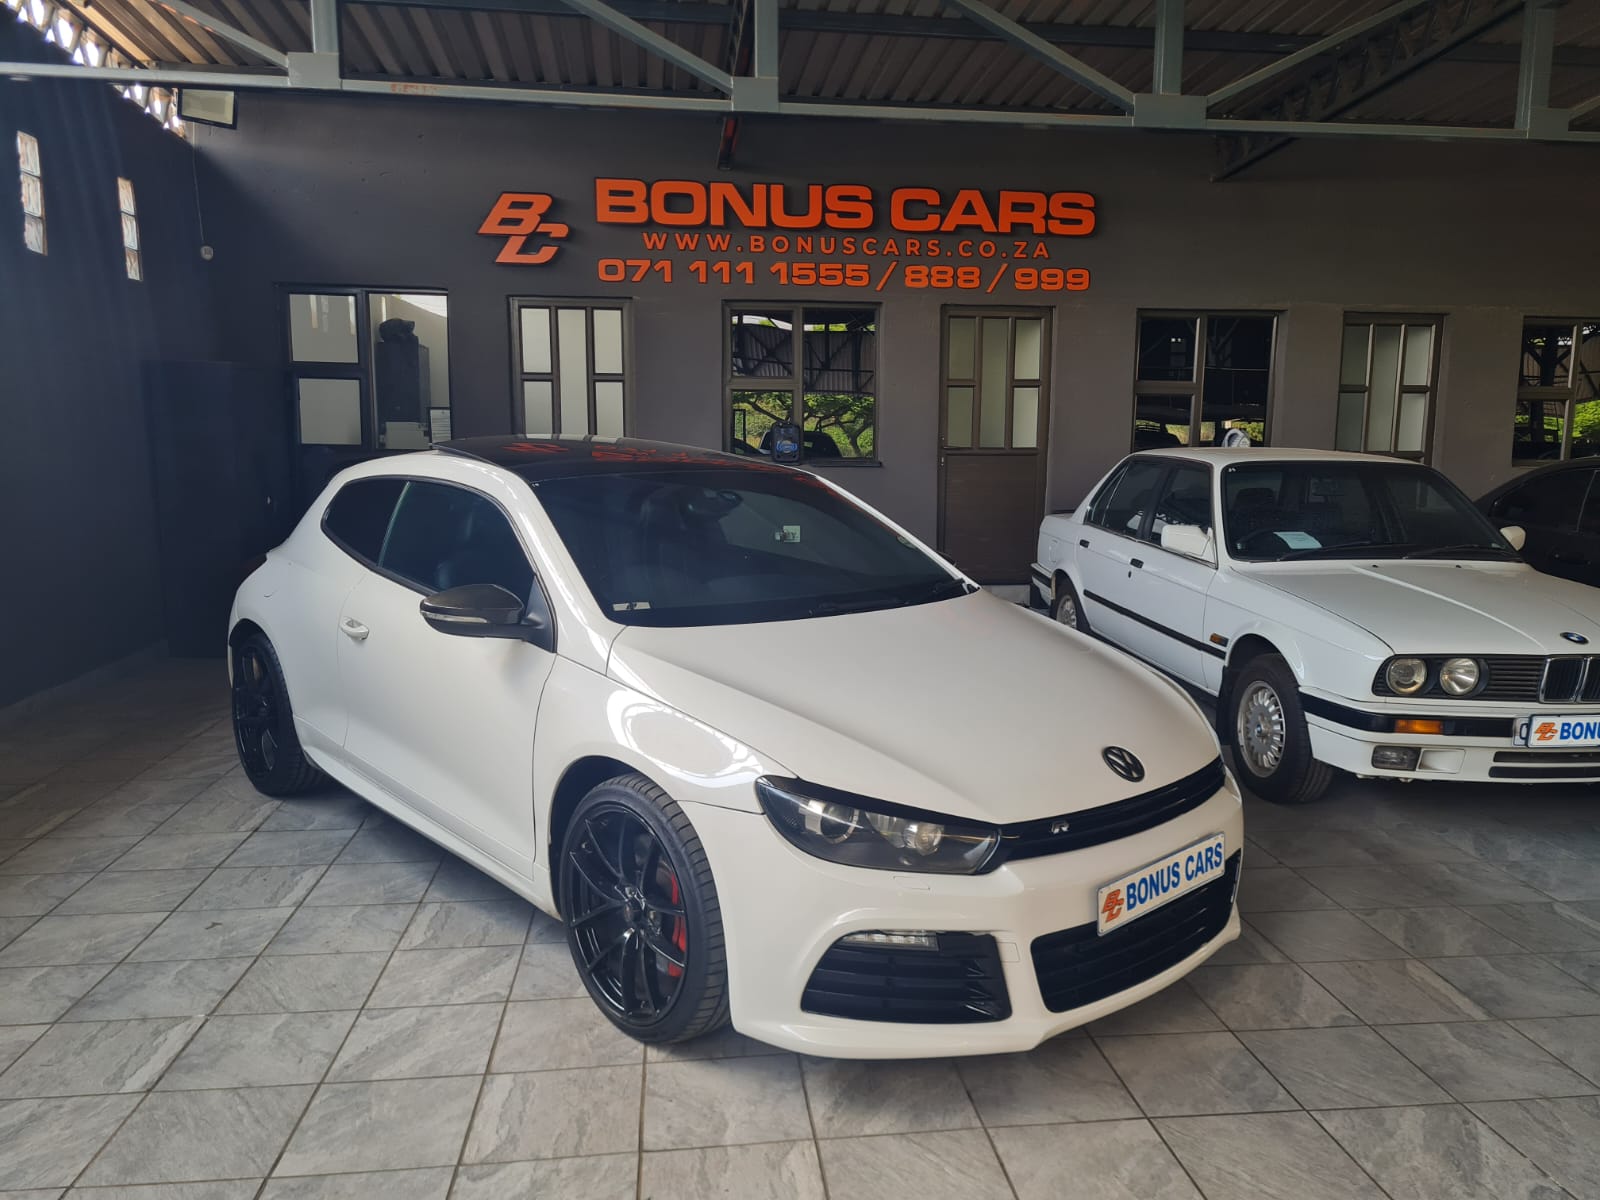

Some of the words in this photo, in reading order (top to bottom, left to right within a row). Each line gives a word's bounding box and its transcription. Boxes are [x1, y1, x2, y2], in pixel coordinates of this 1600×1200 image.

[477, 192, 569, 264] BC
[595, 178, 874, 229] BONUS
[890, 187, 1096, 236] CARS
[597, 258, 673, 283] 071
[688, 260, 754, 284] 111
[642, 231, 1049, 259] WWW.BONUSCARS.CO.ZA
[1126, 861, 1181, 912] BONUS
[1185, 842, 1223, 881] CARS
